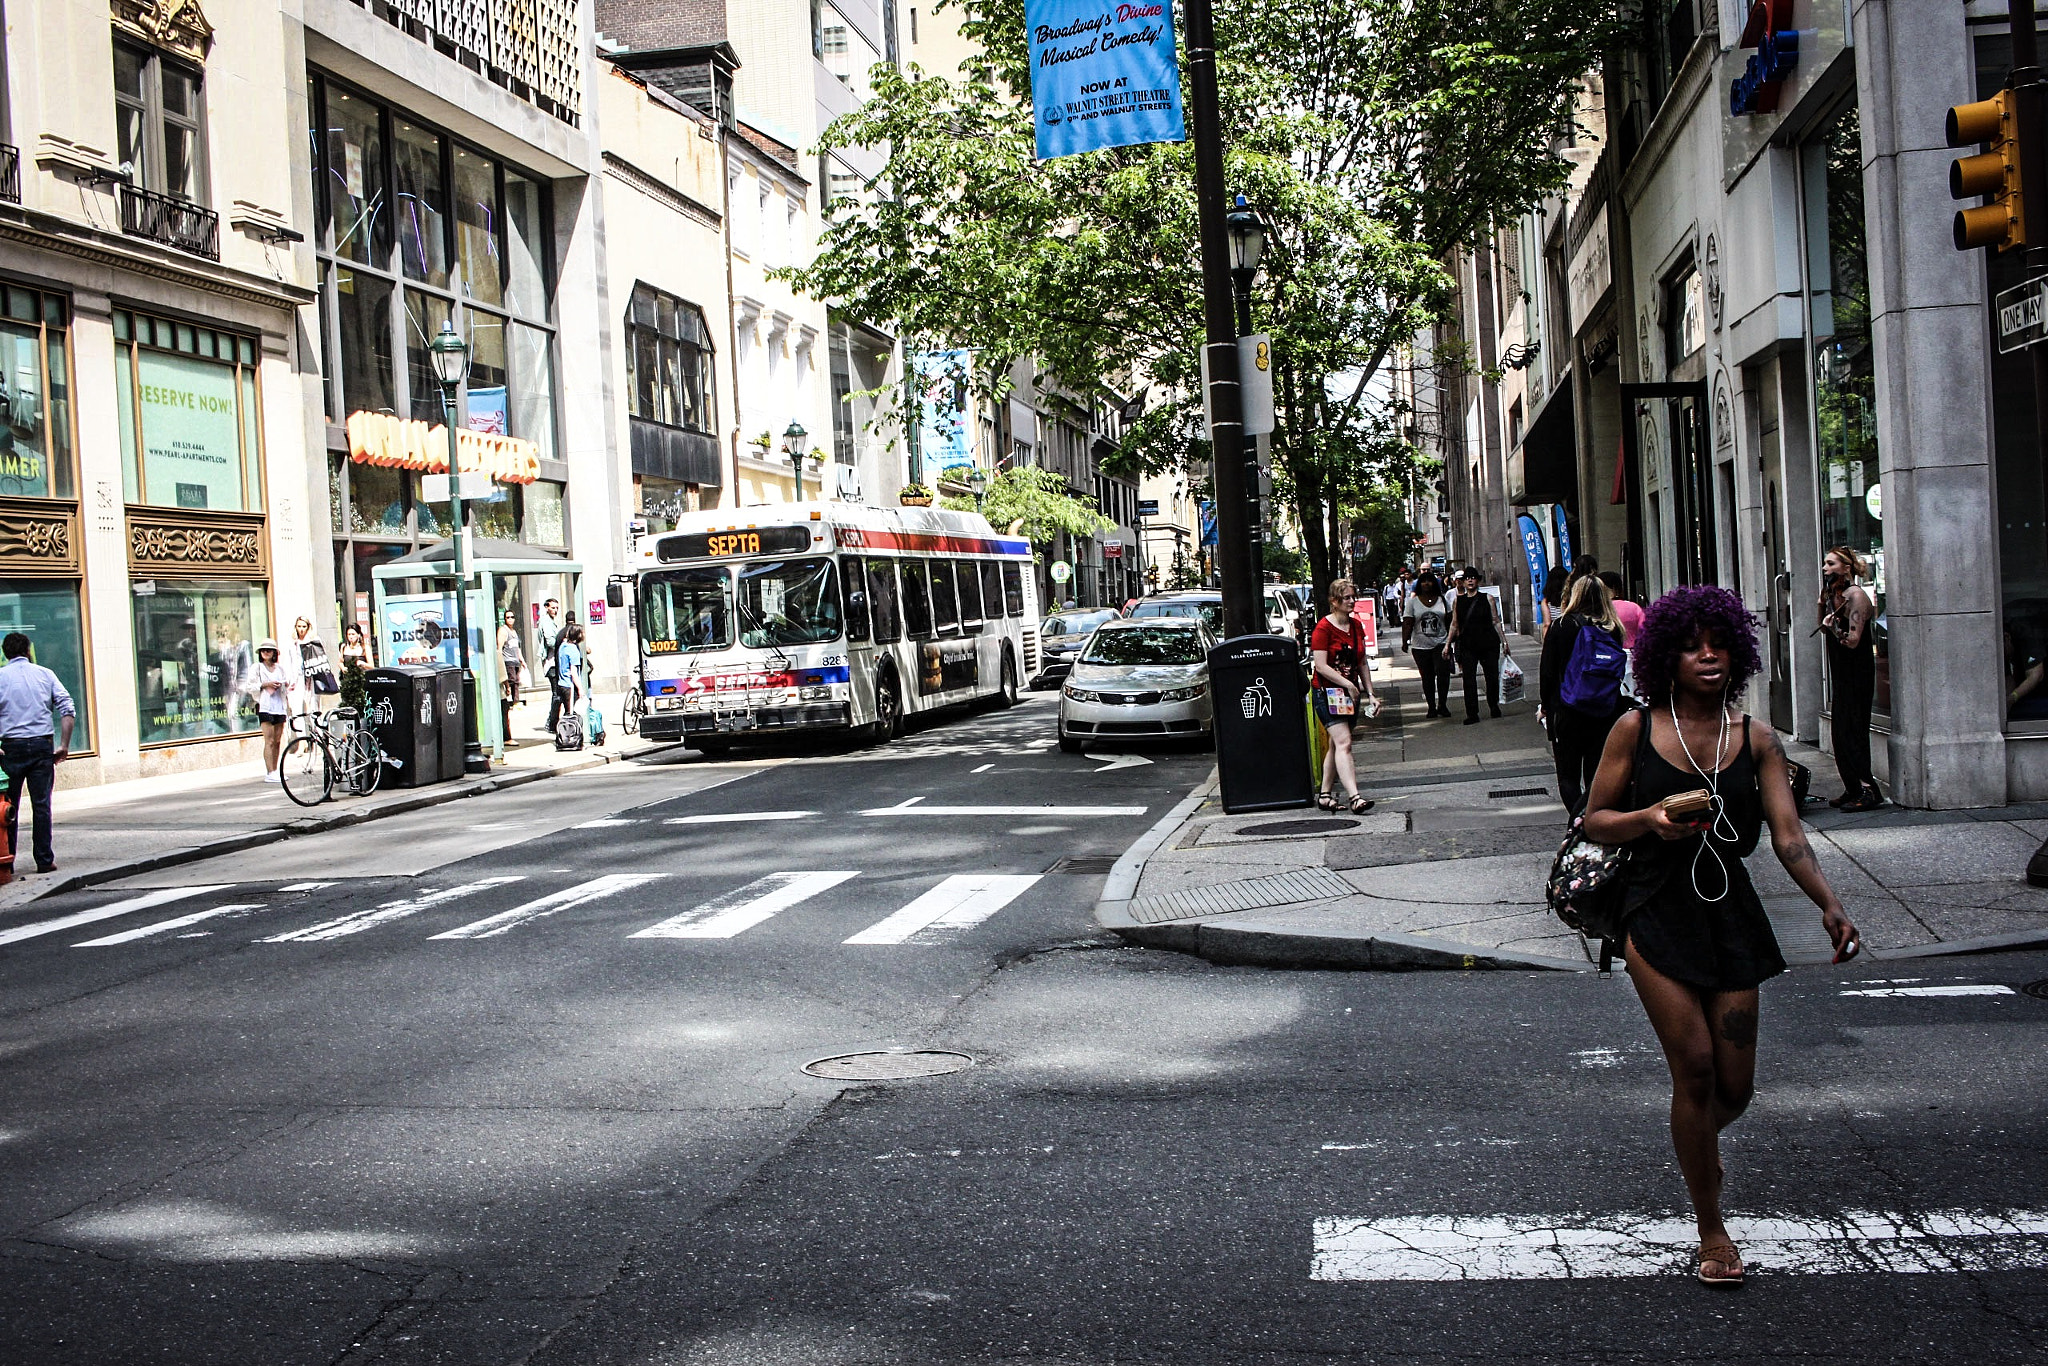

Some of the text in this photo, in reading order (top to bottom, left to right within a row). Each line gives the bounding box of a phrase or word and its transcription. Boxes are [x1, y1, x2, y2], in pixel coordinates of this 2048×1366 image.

[1035, 3, 1163, 44] Broadway's Divine
[1040, 25, 1163, 67] Musical Comedy!
[1080, 77, 1128, 95] NOW AT
[1066, 89, 1170, 114] WALNUT STREET THEATRE
[1081, 112, 1098, 121] AND
[1100, 105, 1136, 117] WALNUT
[1138, 102, 1171, 111] STREETS
[2003, 297, 2041, 332] ONE WAY
[139, 384, 233, 416] RESERVE NOW!
[0, 454, 41, 477] MER
[148, 448, 227, 464] WWW.PEARL-APARTMENTS.COM
[707, 533, 760, 556] SEPTA
[1525, 531, 1539, 571] EYES
[649, 641, 678, 652] 5002
[822, 655, 848, 666] 8283
[716, 675, 768, 691] SEPTA
